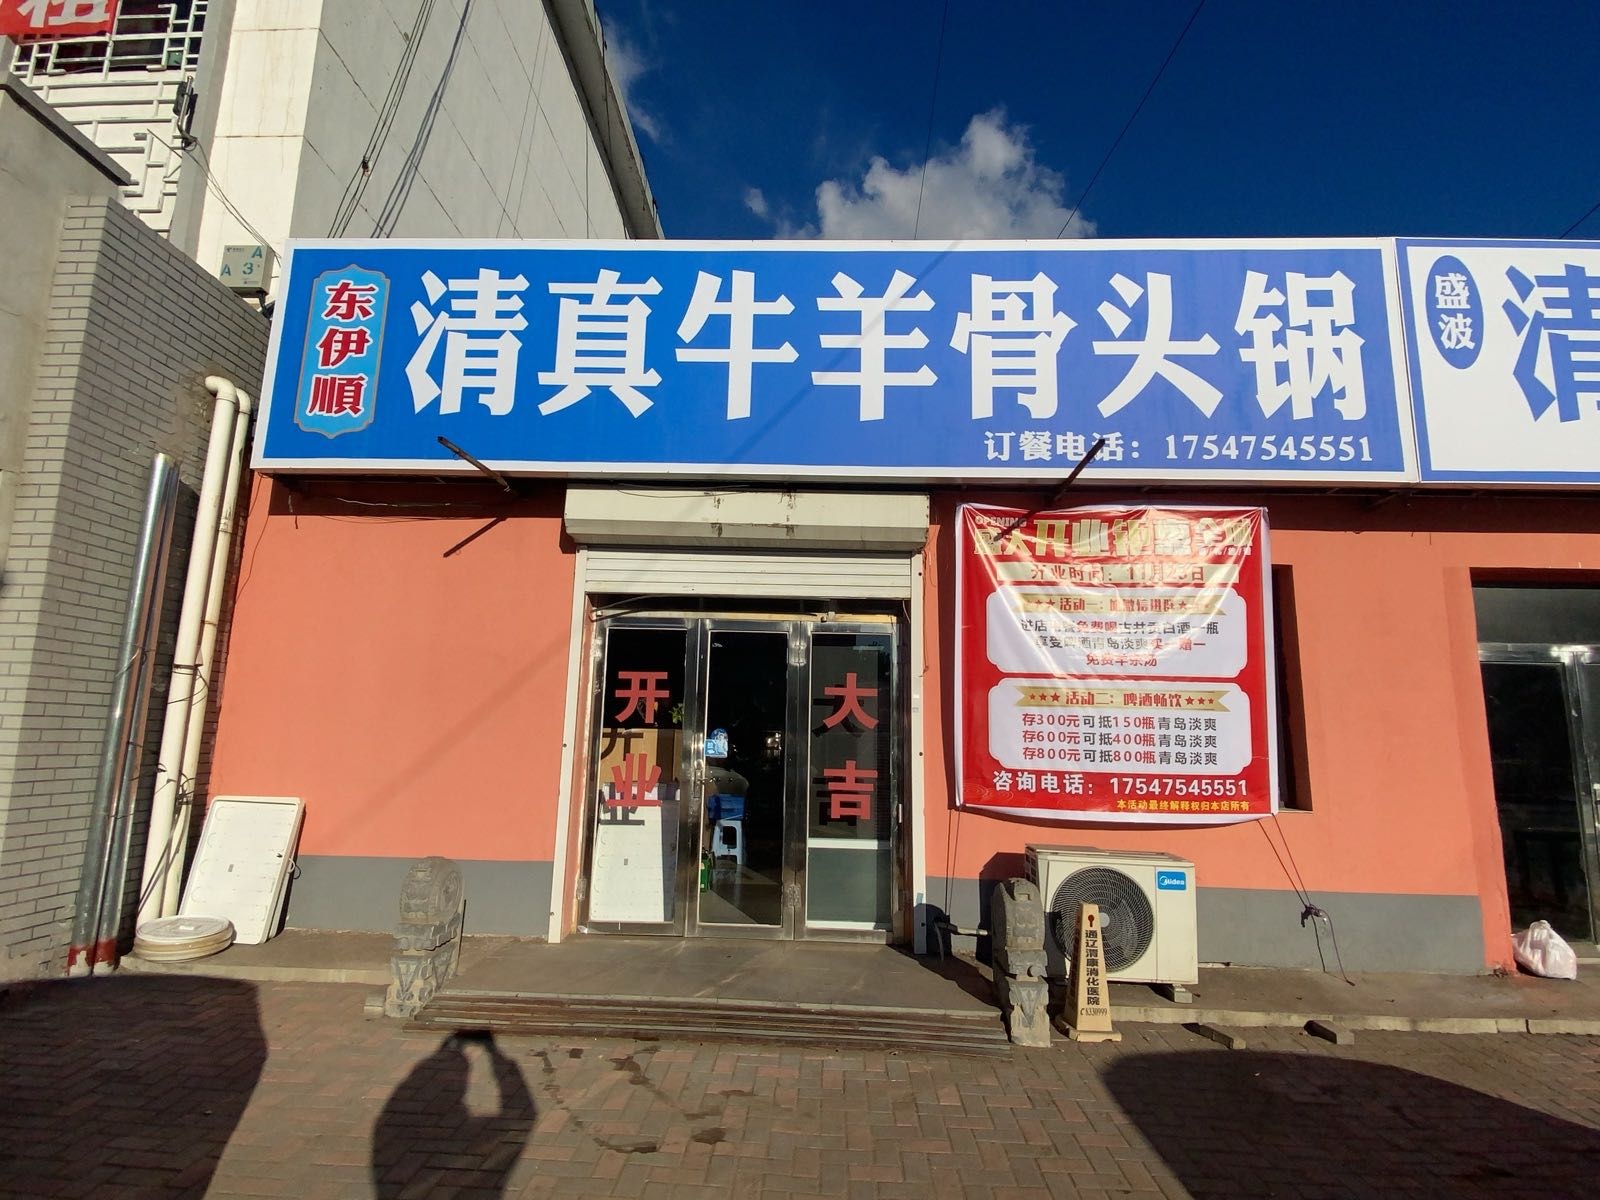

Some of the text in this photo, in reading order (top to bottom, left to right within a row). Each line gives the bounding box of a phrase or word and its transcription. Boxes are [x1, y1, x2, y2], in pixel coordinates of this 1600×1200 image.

[1434, 271, 1476, 350] 盛波
[405, 267, 1367, 421] 清真牛羊骨头锅
[823, 672, 879, 820] 大吉
[1022, 713, 1217, 731] 存300元可抵150瓶青岛淡爽
[1022, 730, 1218, 748] 存600元可抵400瓶青岛淡爽
[1022, 747, 1218, 766] 存800元可抵800瓶青岛淡爽
